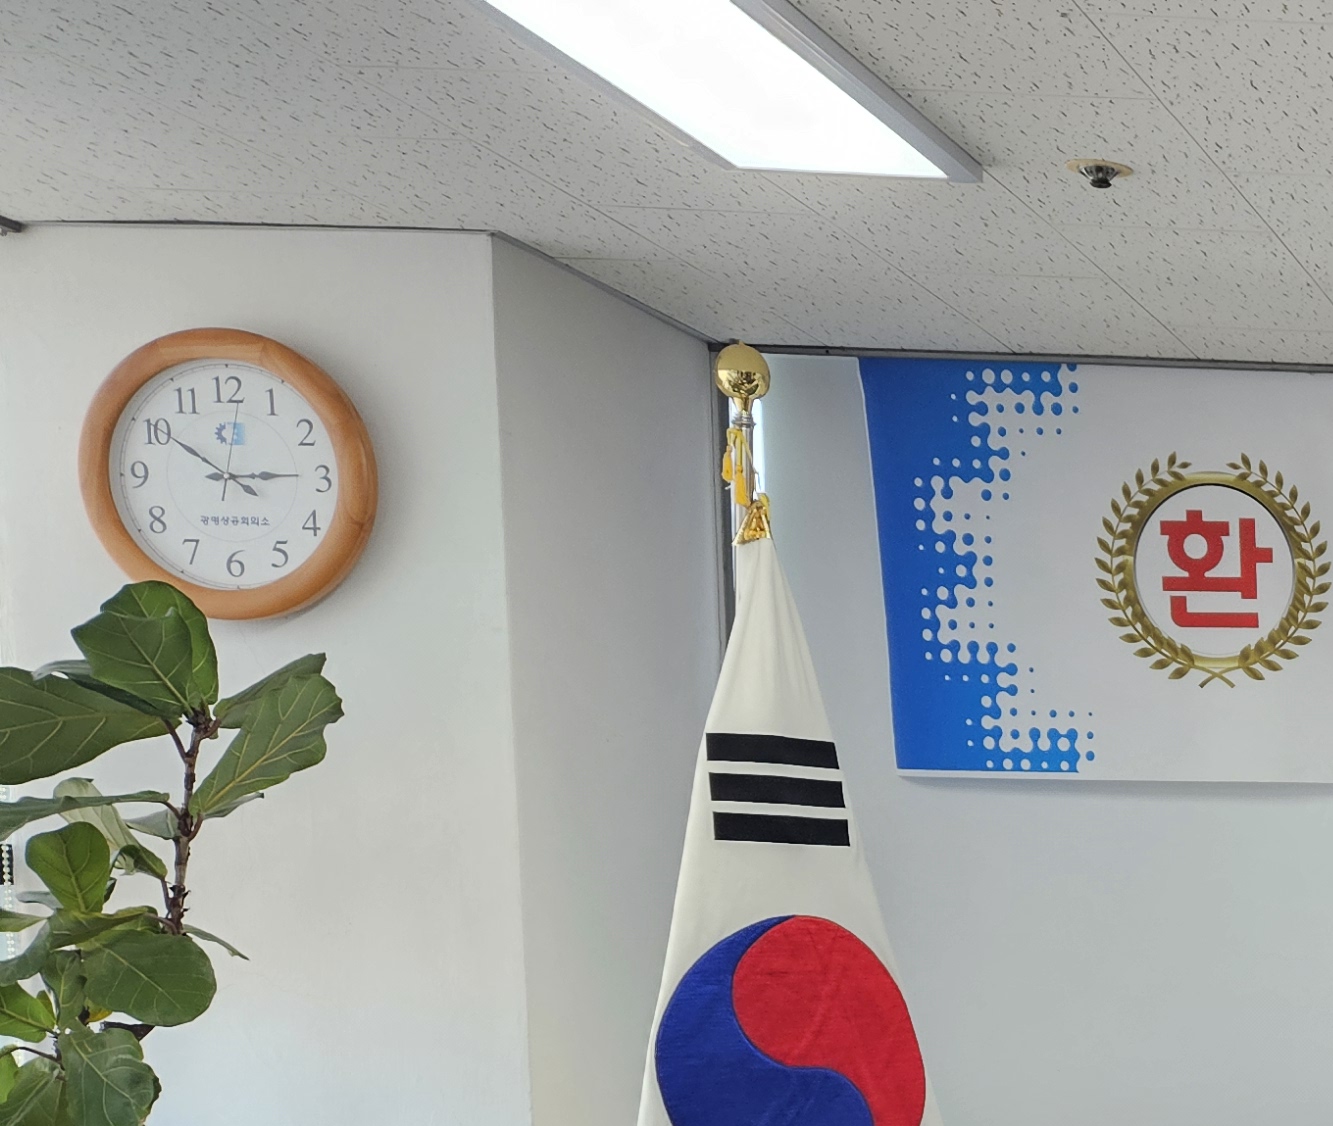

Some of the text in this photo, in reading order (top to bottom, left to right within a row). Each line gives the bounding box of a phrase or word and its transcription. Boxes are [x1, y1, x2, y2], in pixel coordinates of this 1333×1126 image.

[174, 386, 200, 415] 11
[212, 375, 245, 404] 12
[264, 388, 277, 416] 1
[143, 417, 172, 446] 10
[296, 418, 316, 447] 2
[130, 460, 149, 489] 9
[314, 464, 333, 493] 3
[148, 505, 167, 534] 8
[301, 509, 321, 537] 4
[182, 538, 200, 566] 7
[226, 549, 245, 578] 6
[271, 540, 289, 568] 5
[1159, 509, 1274, 628] 환
